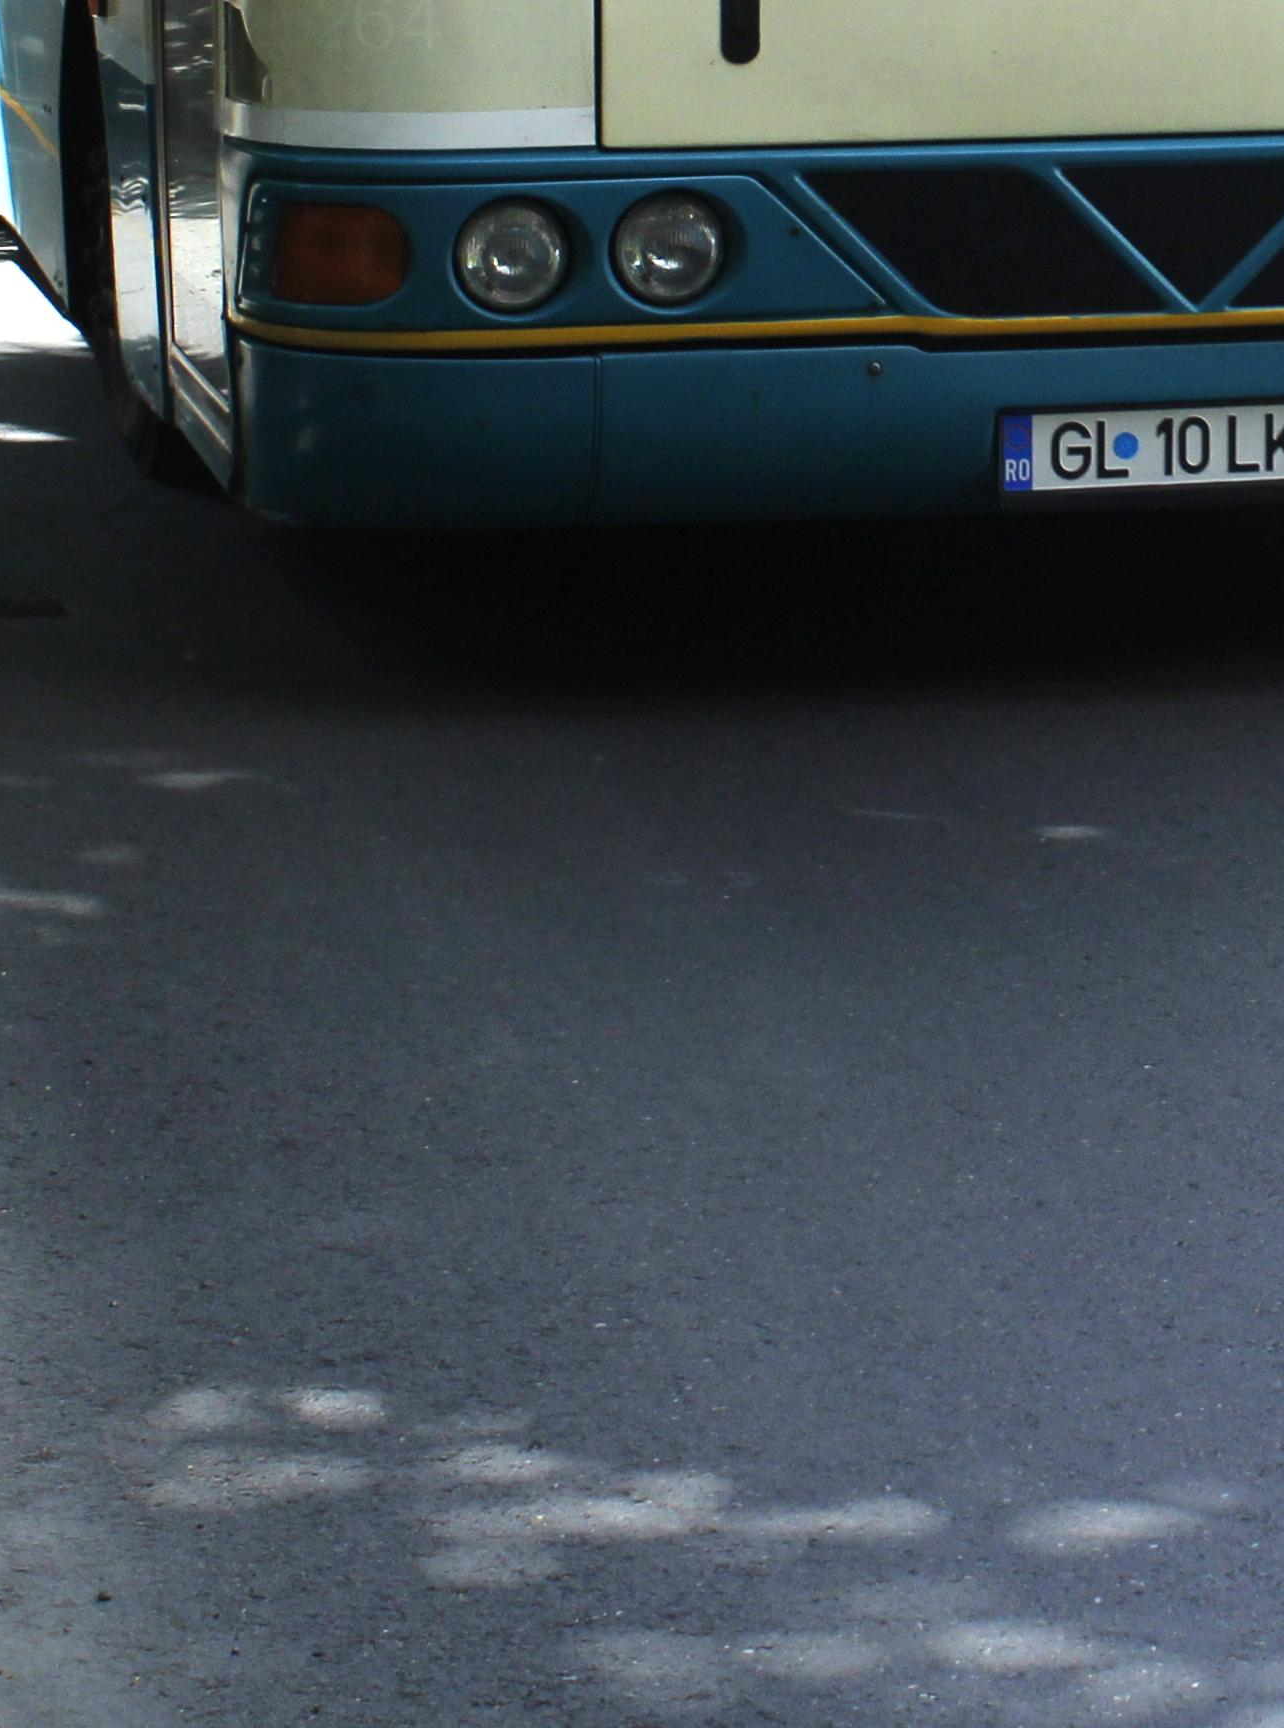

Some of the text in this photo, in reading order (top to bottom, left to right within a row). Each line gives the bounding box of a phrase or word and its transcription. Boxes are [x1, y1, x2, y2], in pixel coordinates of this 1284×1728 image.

[1005, 458, 1030, 481] RO
[1050, 420, 1130, 480] GL
[1156, 415, 1211, 476] 10
